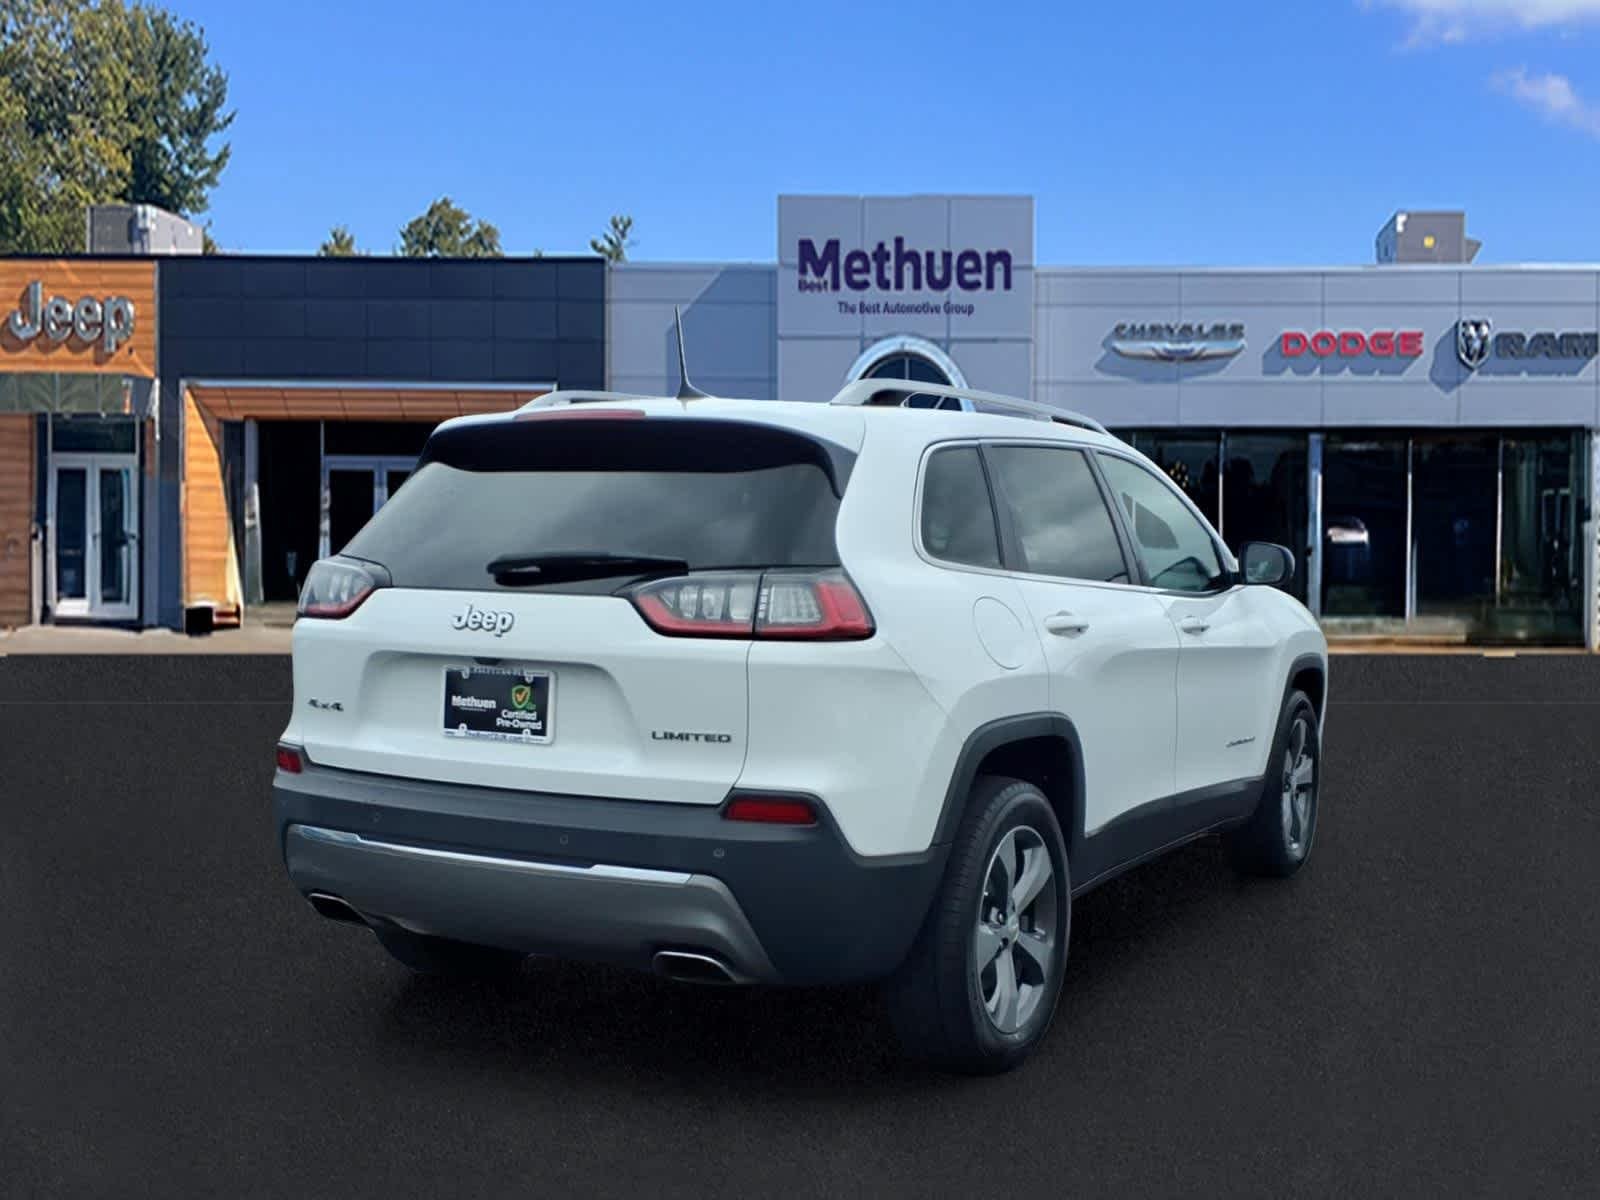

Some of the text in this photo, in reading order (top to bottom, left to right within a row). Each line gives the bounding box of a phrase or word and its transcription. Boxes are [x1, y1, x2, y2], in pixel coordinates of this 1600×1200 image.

[798, 236, 1012, 292] Methuen
[8, 280, 135, 353] Jeep
[838, 301, 975, 317] The Best Automotive Group
[1282, 331, 1424, 357] DODGE
[1494, 332, 1598, 359] RAM
[452, 604, 514, 637] Jeep
[451, 695, 497, 709] Methuen
[496, 717, 542, 730] Pre-Owned
[501, 709, 537, 720] Certified
[652, 731, 731, 743] LIMITED
